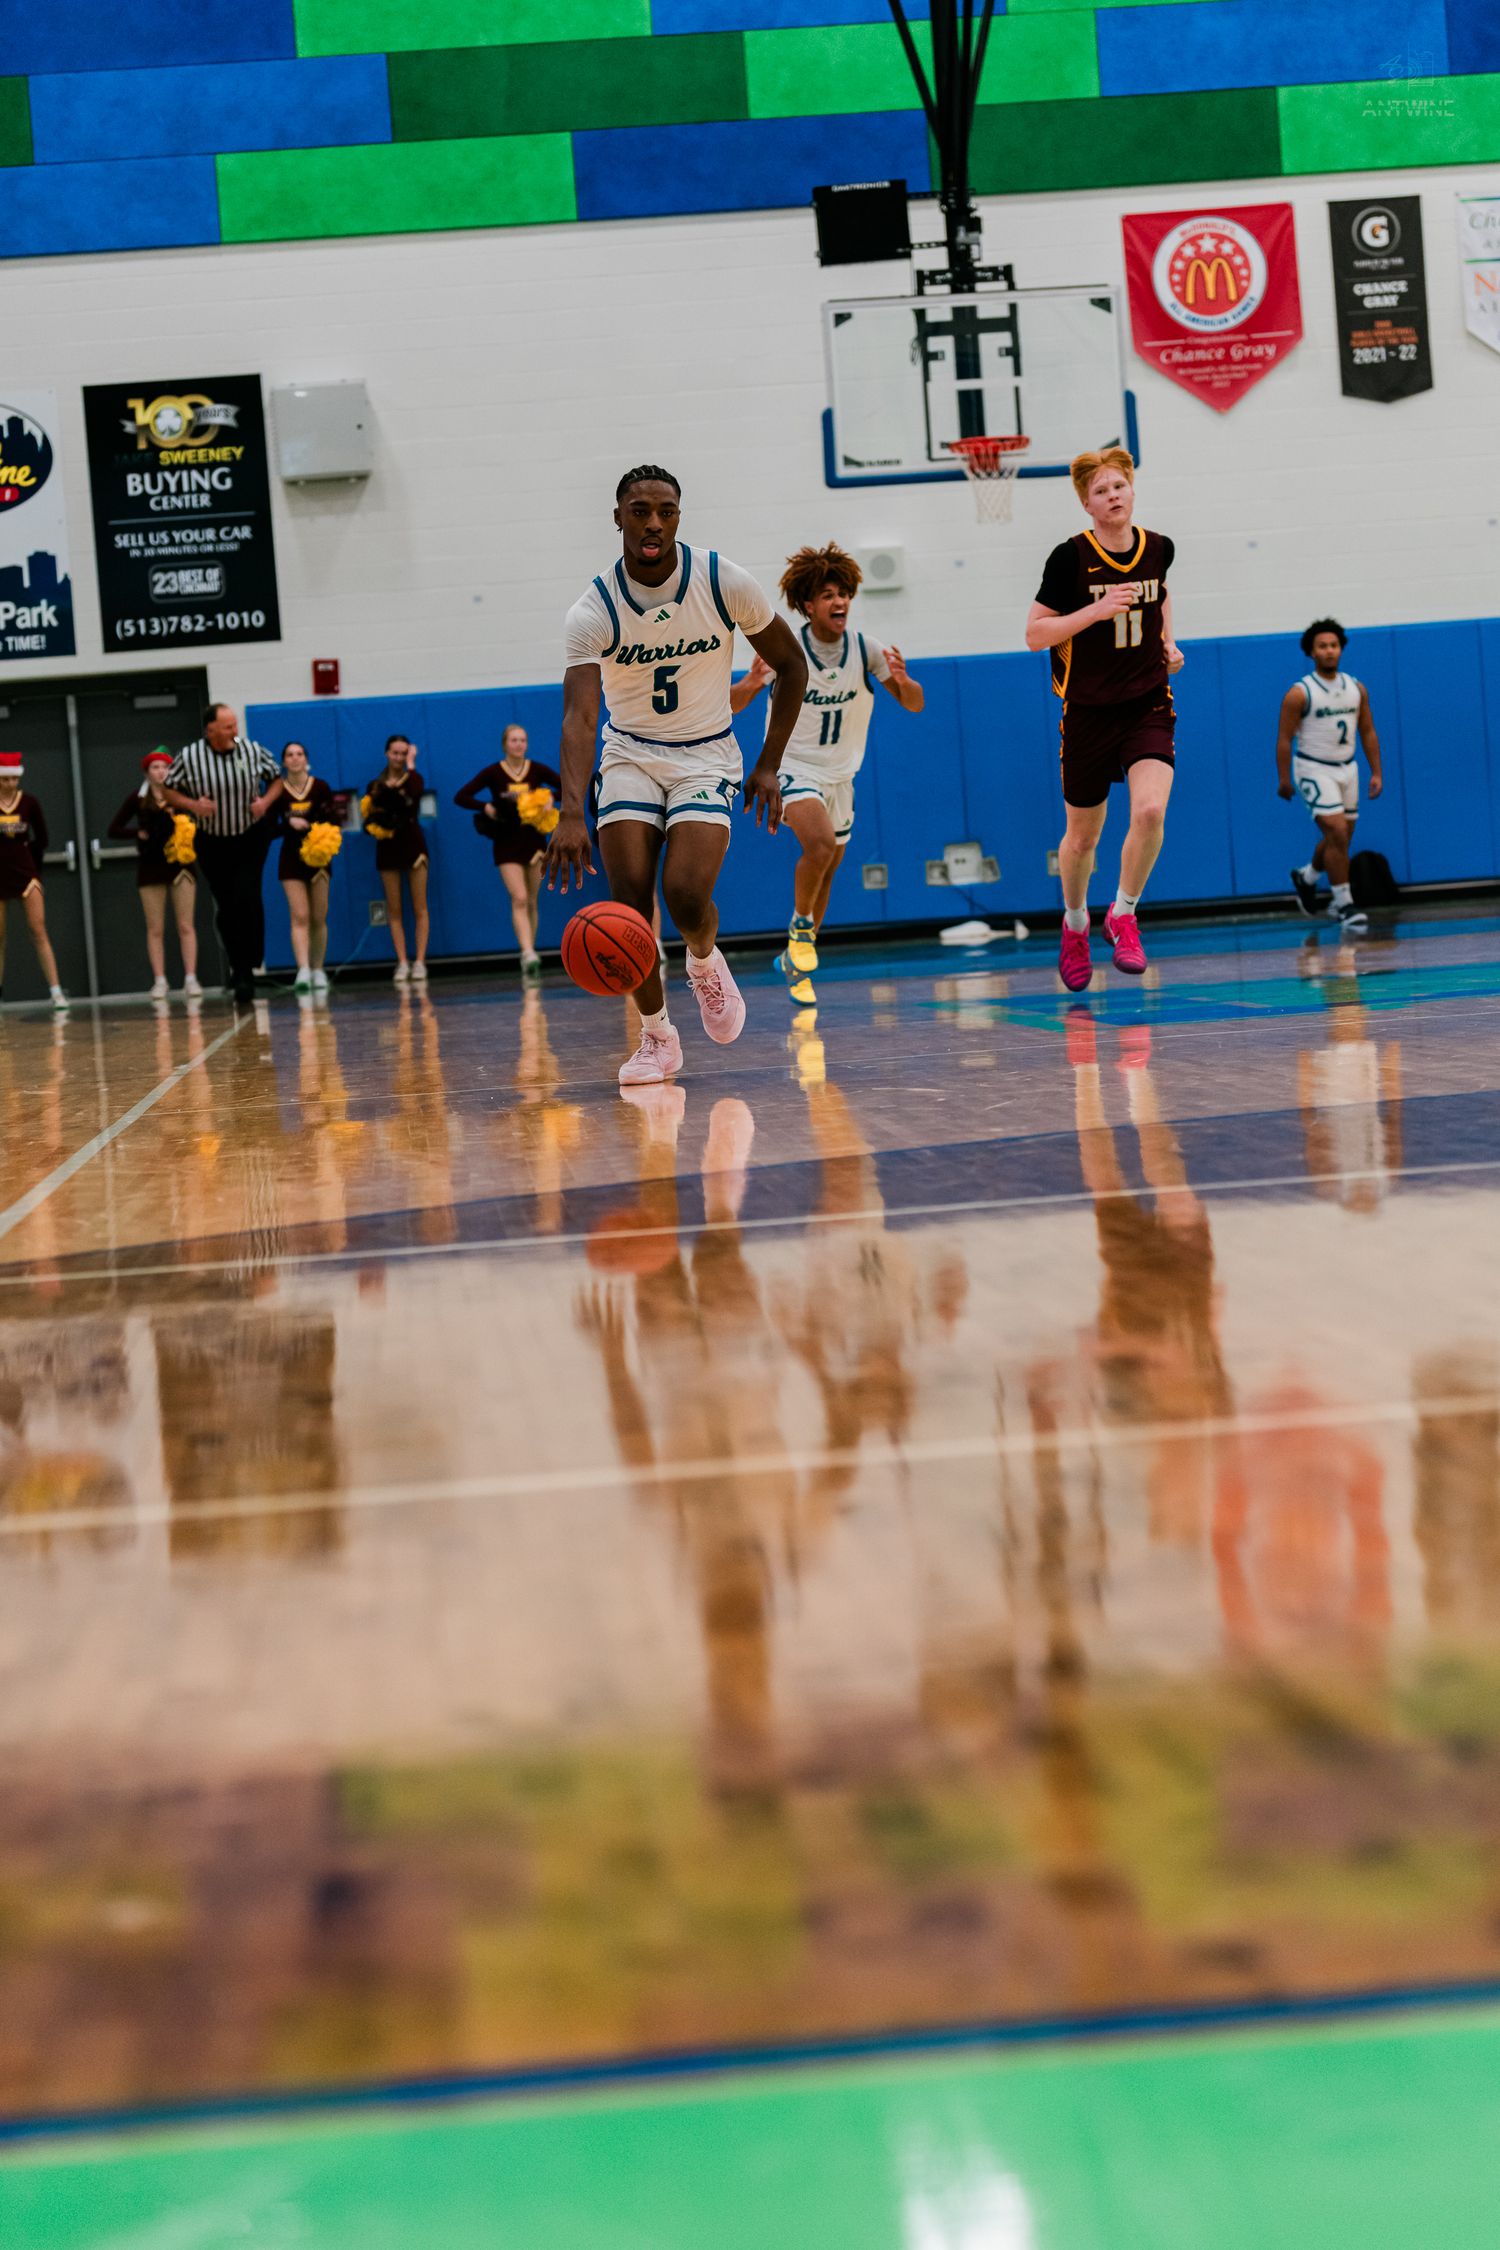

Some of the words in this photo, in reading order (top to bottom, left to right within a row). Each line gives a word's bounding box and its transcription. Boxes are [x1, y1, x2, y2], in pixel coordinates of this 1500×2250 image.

[1159, 347, 1226, 364] Chance
[1229, 343, 1277, 361] Gray
[159, 446, 244, 465] SWEENEY
[126, 467, 233, 496] BUYING
[149, 493, 212, 511] CENTER
[114, 533, 146, 548] SELL
[149, 531, 170, 545] US
[172, 528, 217, 544] YOUR
[219, 525, 253, 540] CAR
[152, 572, 178, 595] 23
[0, 599, 59, 630] Park
[115, 610, 266, 640] (513)782-1010
[1113, 609, 1143, 649] 11
[5, 634, 47, 652] TIME!
[616, 634, 721, 666] Warriors
[651, 664, 682, 715] 5
[819, 709, 842, 746] 11
[1337, 720, 1348, 745] 2
